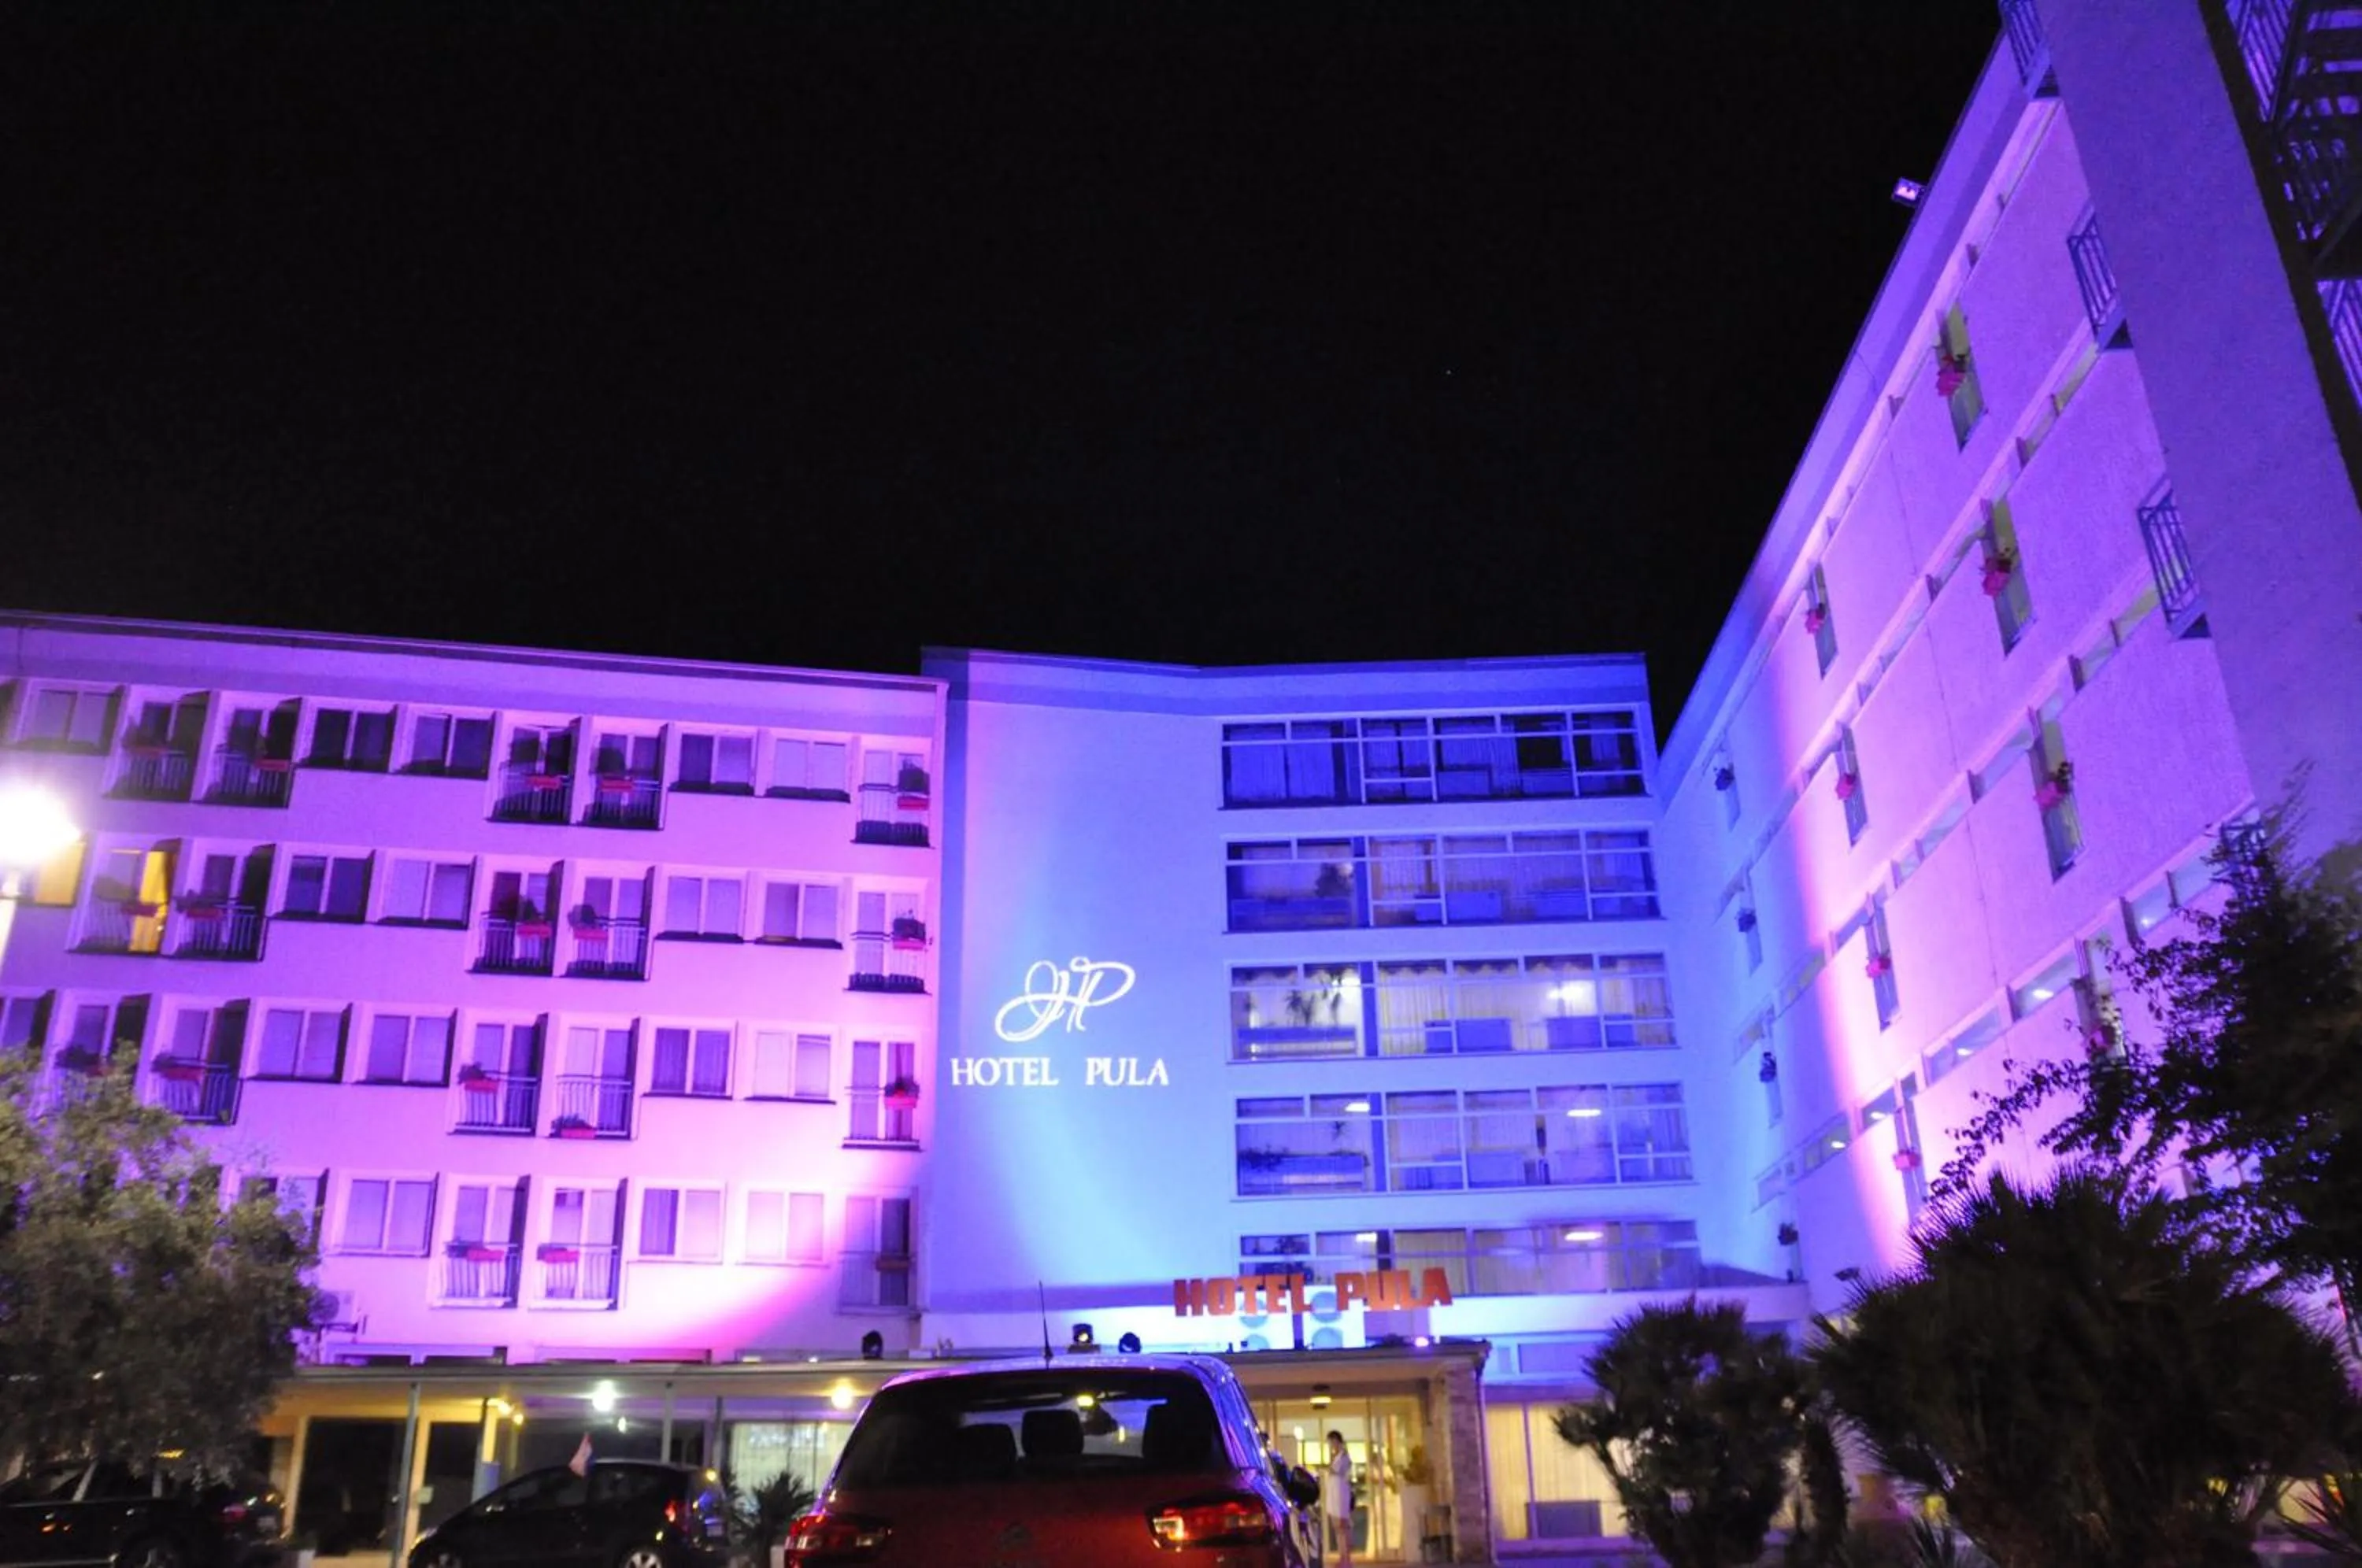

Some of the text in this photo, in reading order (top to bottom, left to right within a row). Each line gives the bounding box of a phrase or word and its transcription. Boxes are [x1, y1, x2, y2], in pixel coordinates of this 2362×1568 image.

[950, 1057, 1169, 1085] HOTEL PULA
[1173, 1267, 1453, 1317] HOTEL PULA
